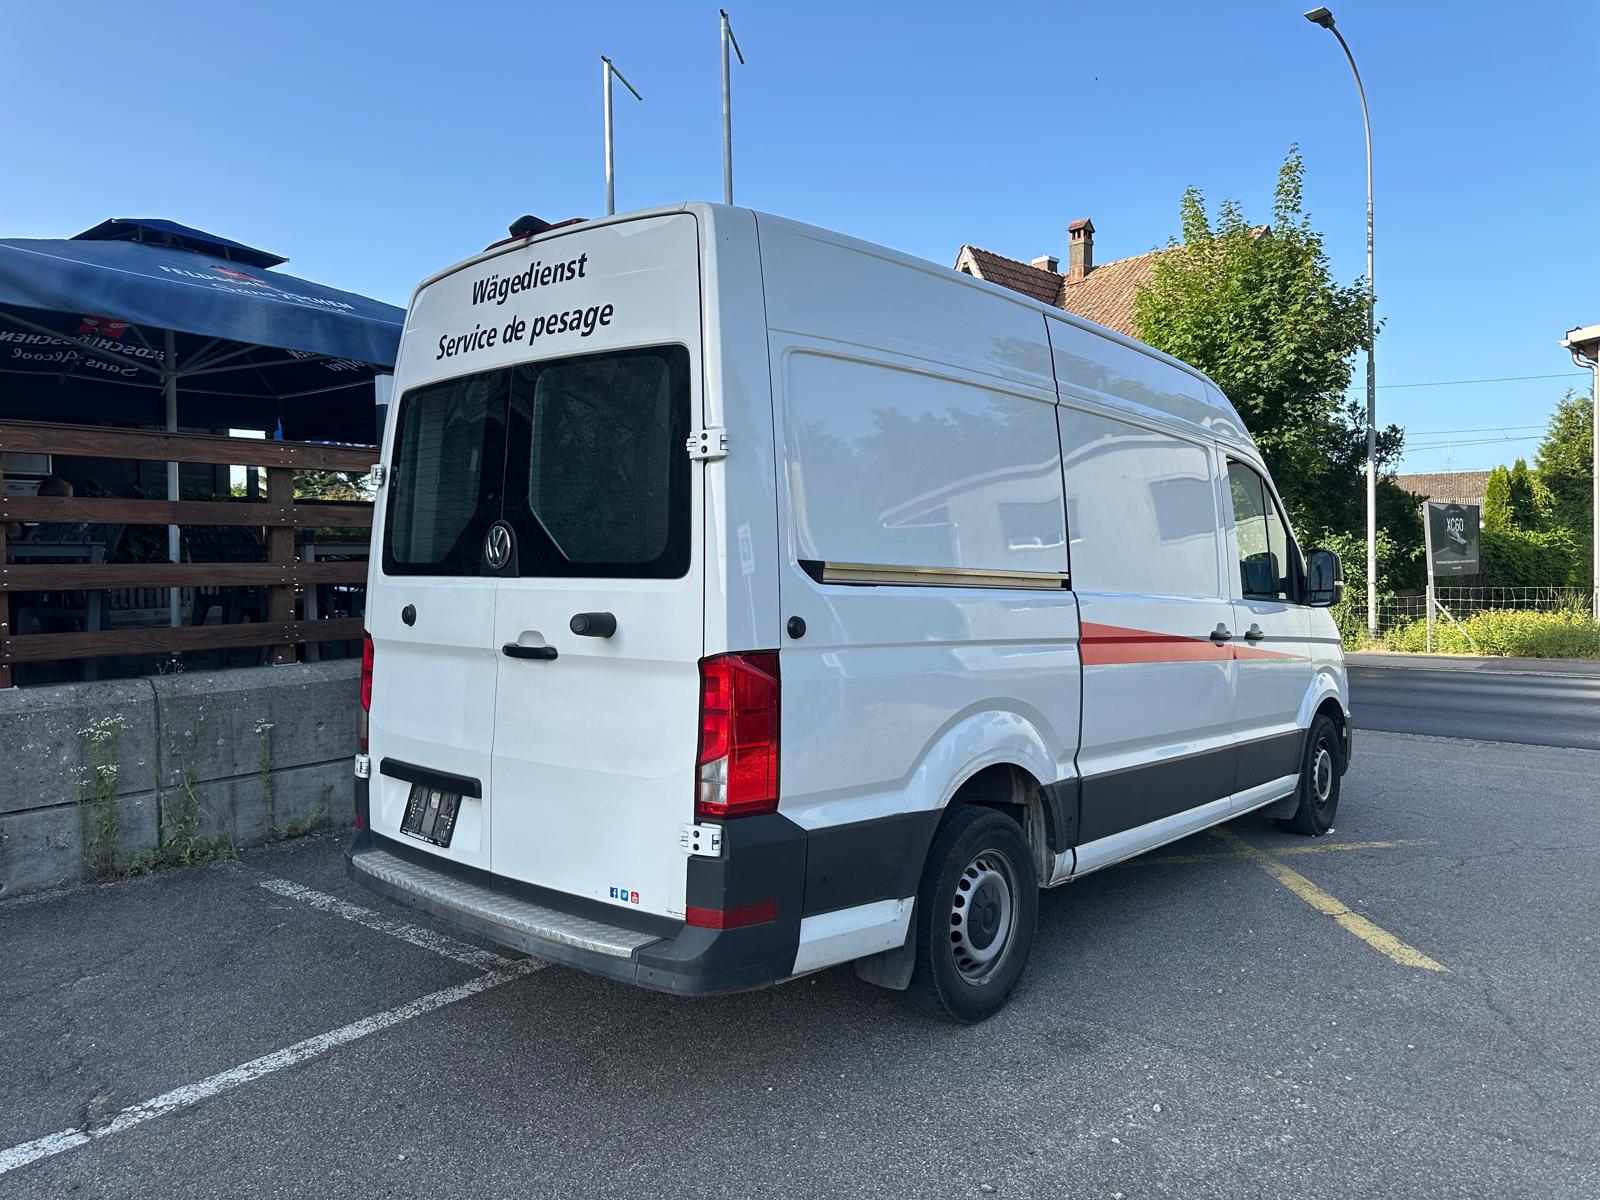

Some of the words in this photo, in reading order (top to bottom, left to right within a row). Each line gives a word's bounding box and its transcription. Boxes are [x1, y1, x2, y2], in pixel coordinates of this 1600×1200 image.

[472, 252, 587, 305] Wägedienst
[436, 323, 498, 361] Service
[502, 315, 526, 344] de
[529, 303, 614, 346] pesage
